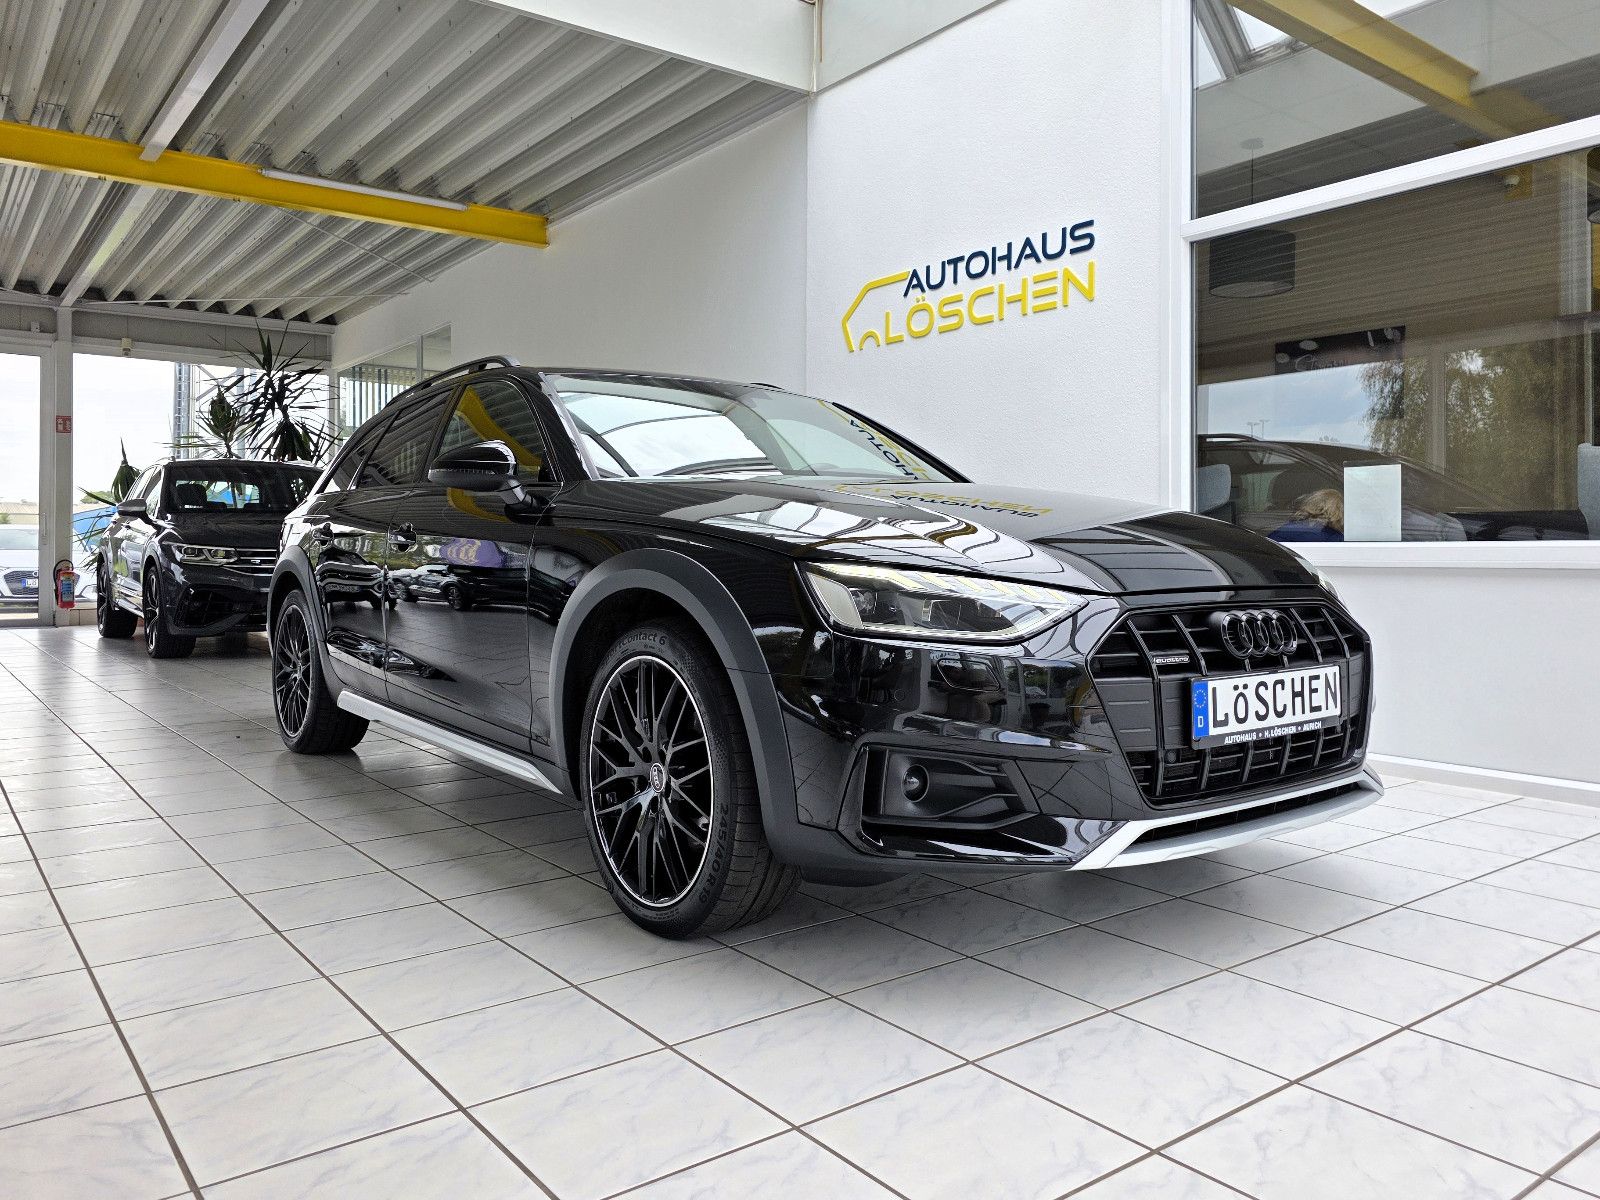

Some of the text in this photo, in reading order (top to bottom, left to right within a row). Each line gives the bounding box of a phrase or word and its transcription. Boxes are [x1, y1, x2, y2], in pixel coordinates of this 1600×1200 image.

[904, 220, 1096, 298] AUTOHAUS
[885, 261, 1096, 346] LÖSCHEN
[1198, 672, 1338, 728] D LÖSCHEN
[1224, 732, 1257, 745] AUTOHAUS
